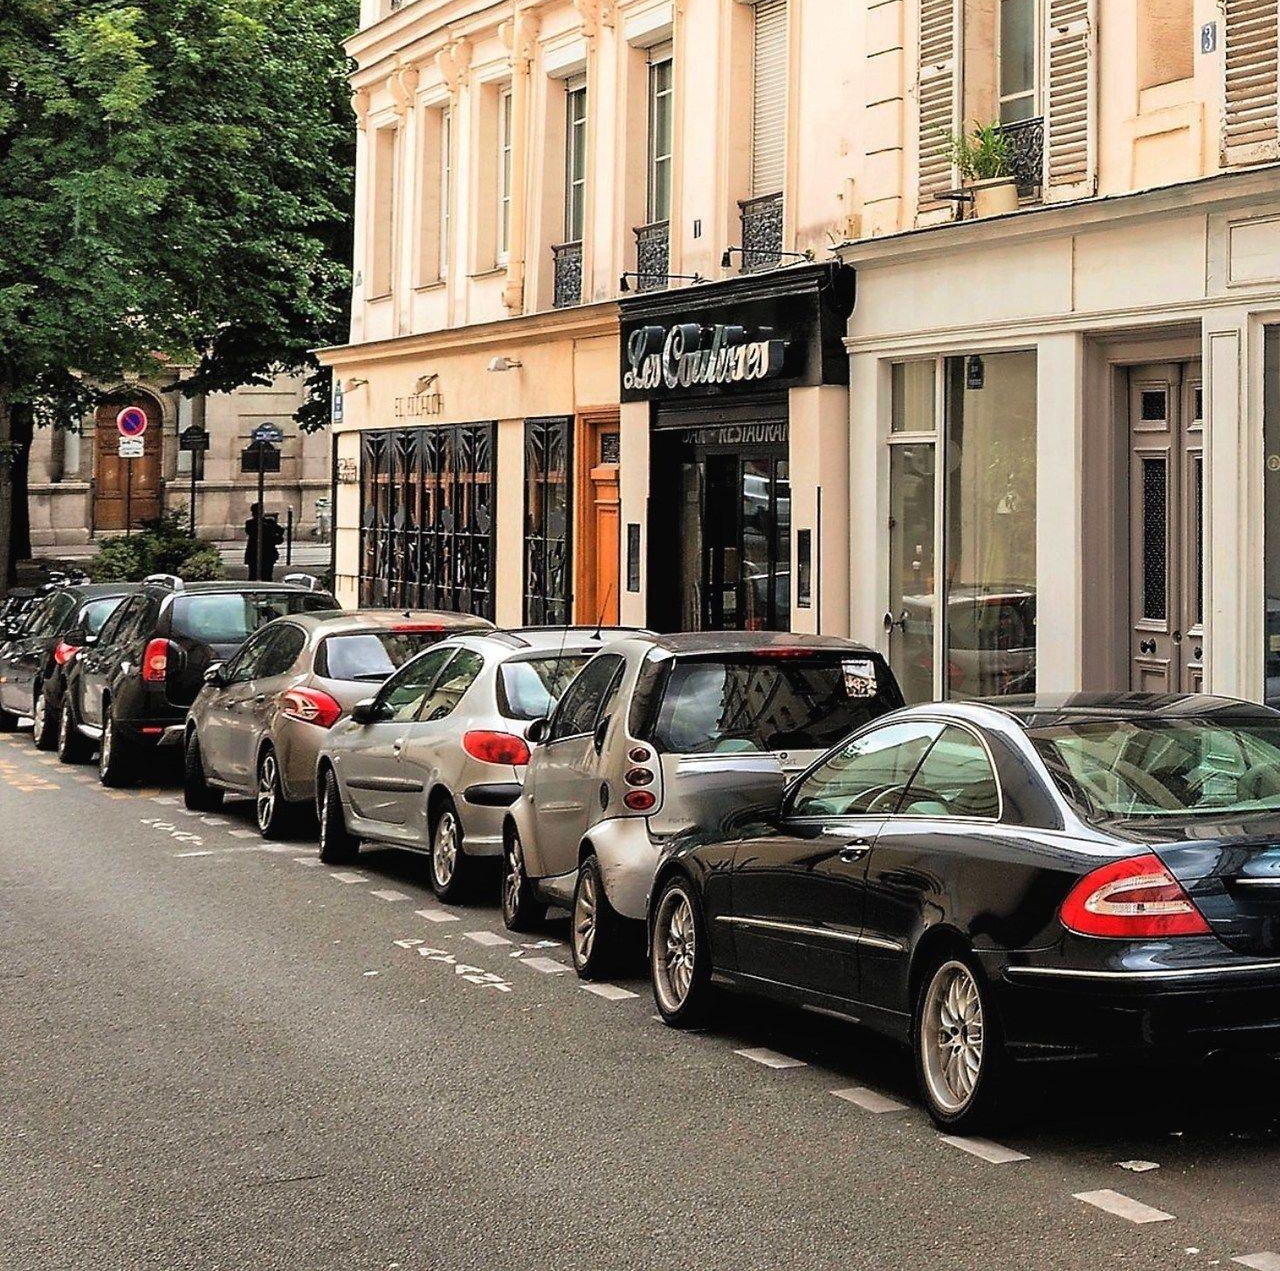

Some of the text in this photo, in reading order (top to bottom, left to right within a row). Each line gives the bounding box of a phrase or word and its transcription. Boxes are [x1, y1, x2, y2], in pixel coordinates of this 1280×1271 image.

[1203, 24, 1213, 52] 3
[623, 323, 778, 389] Les Coulisses
[718, 424, 789, 444] RESTAURAN
